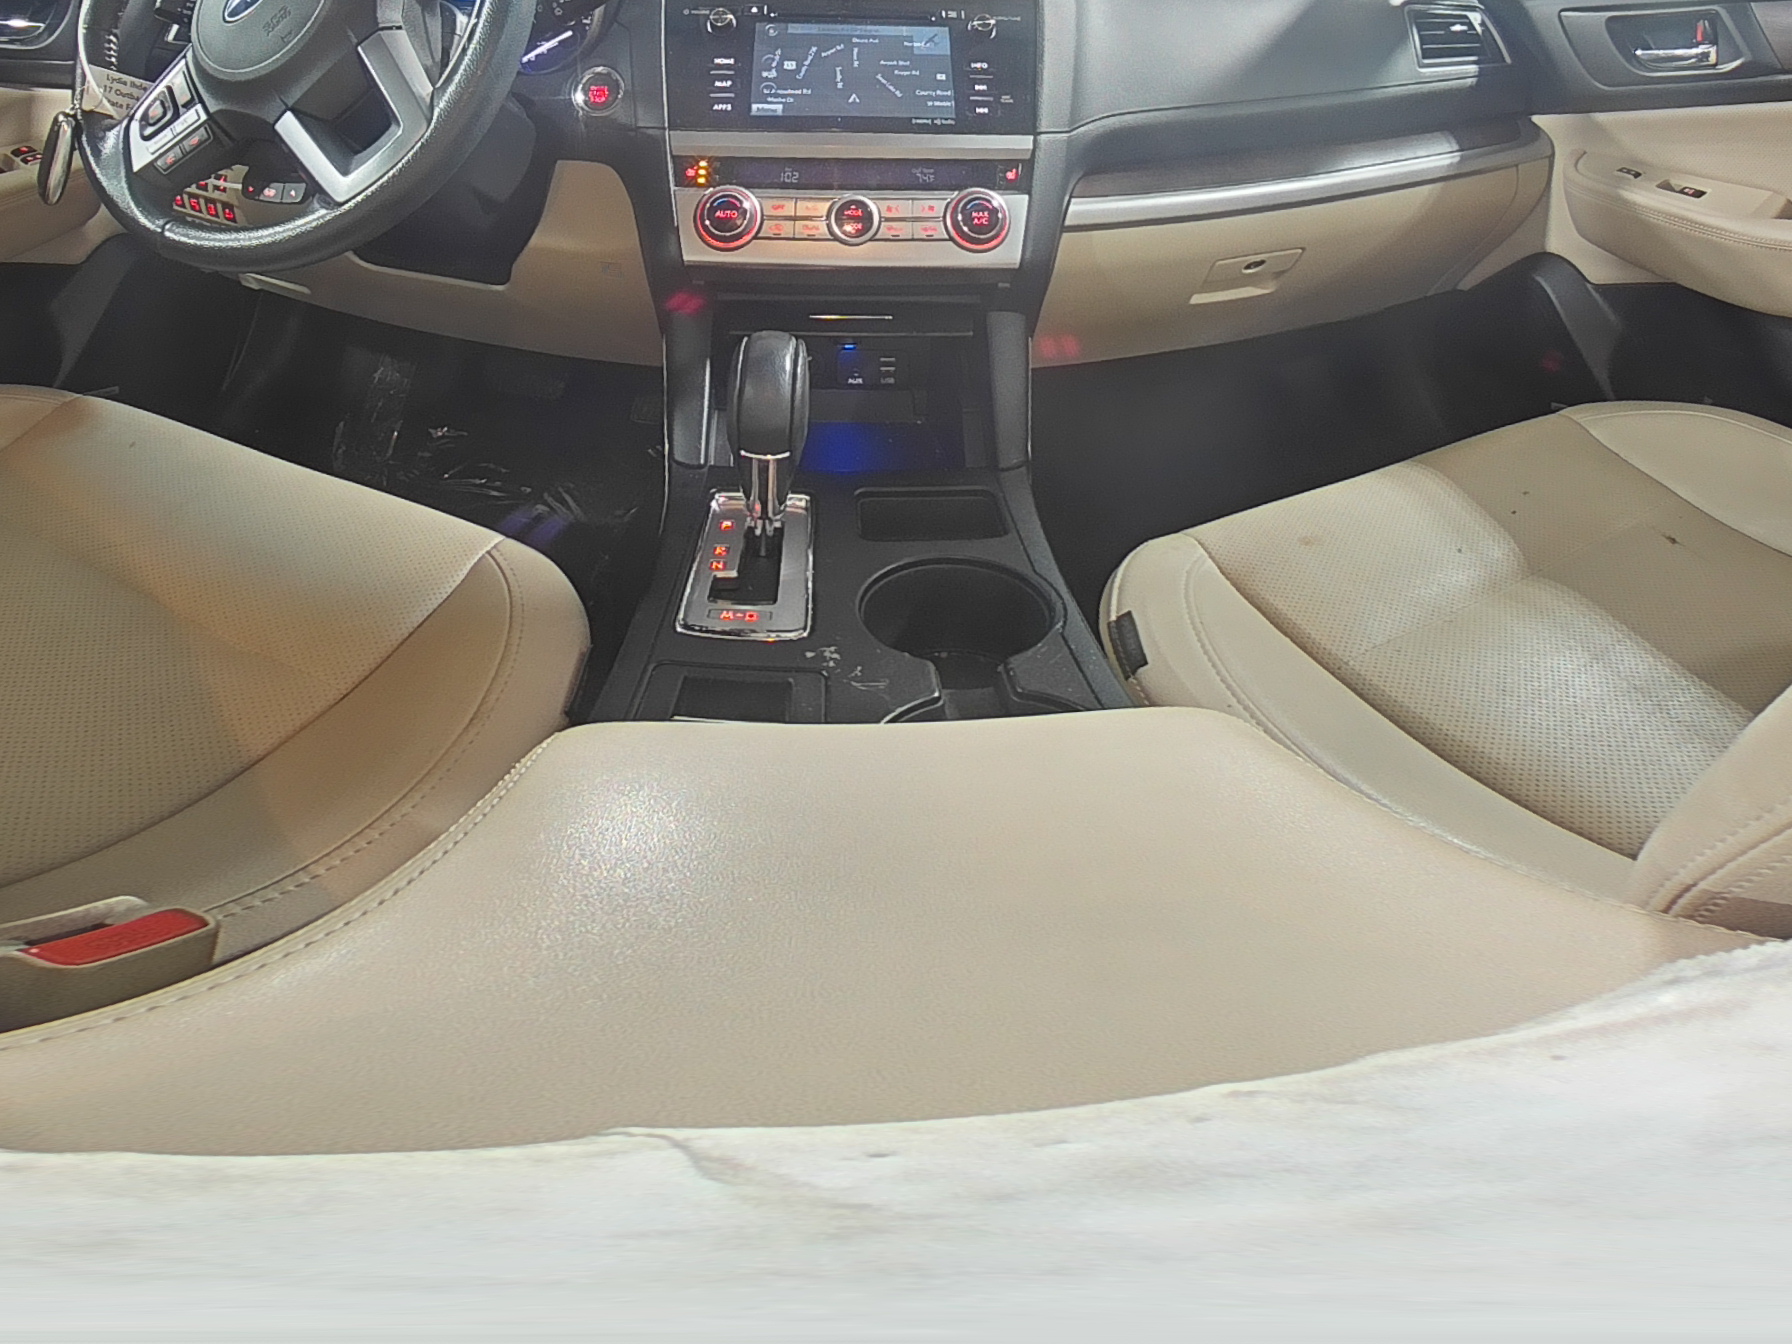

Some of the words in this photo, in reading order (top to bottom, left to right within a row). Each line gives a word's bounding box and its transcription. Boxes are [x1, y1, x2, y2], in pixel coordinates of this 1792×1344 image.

[714, 210, 738, 218] AUTO
[721, 521, 733, 530] P
[712, 560, 724, 569] N
